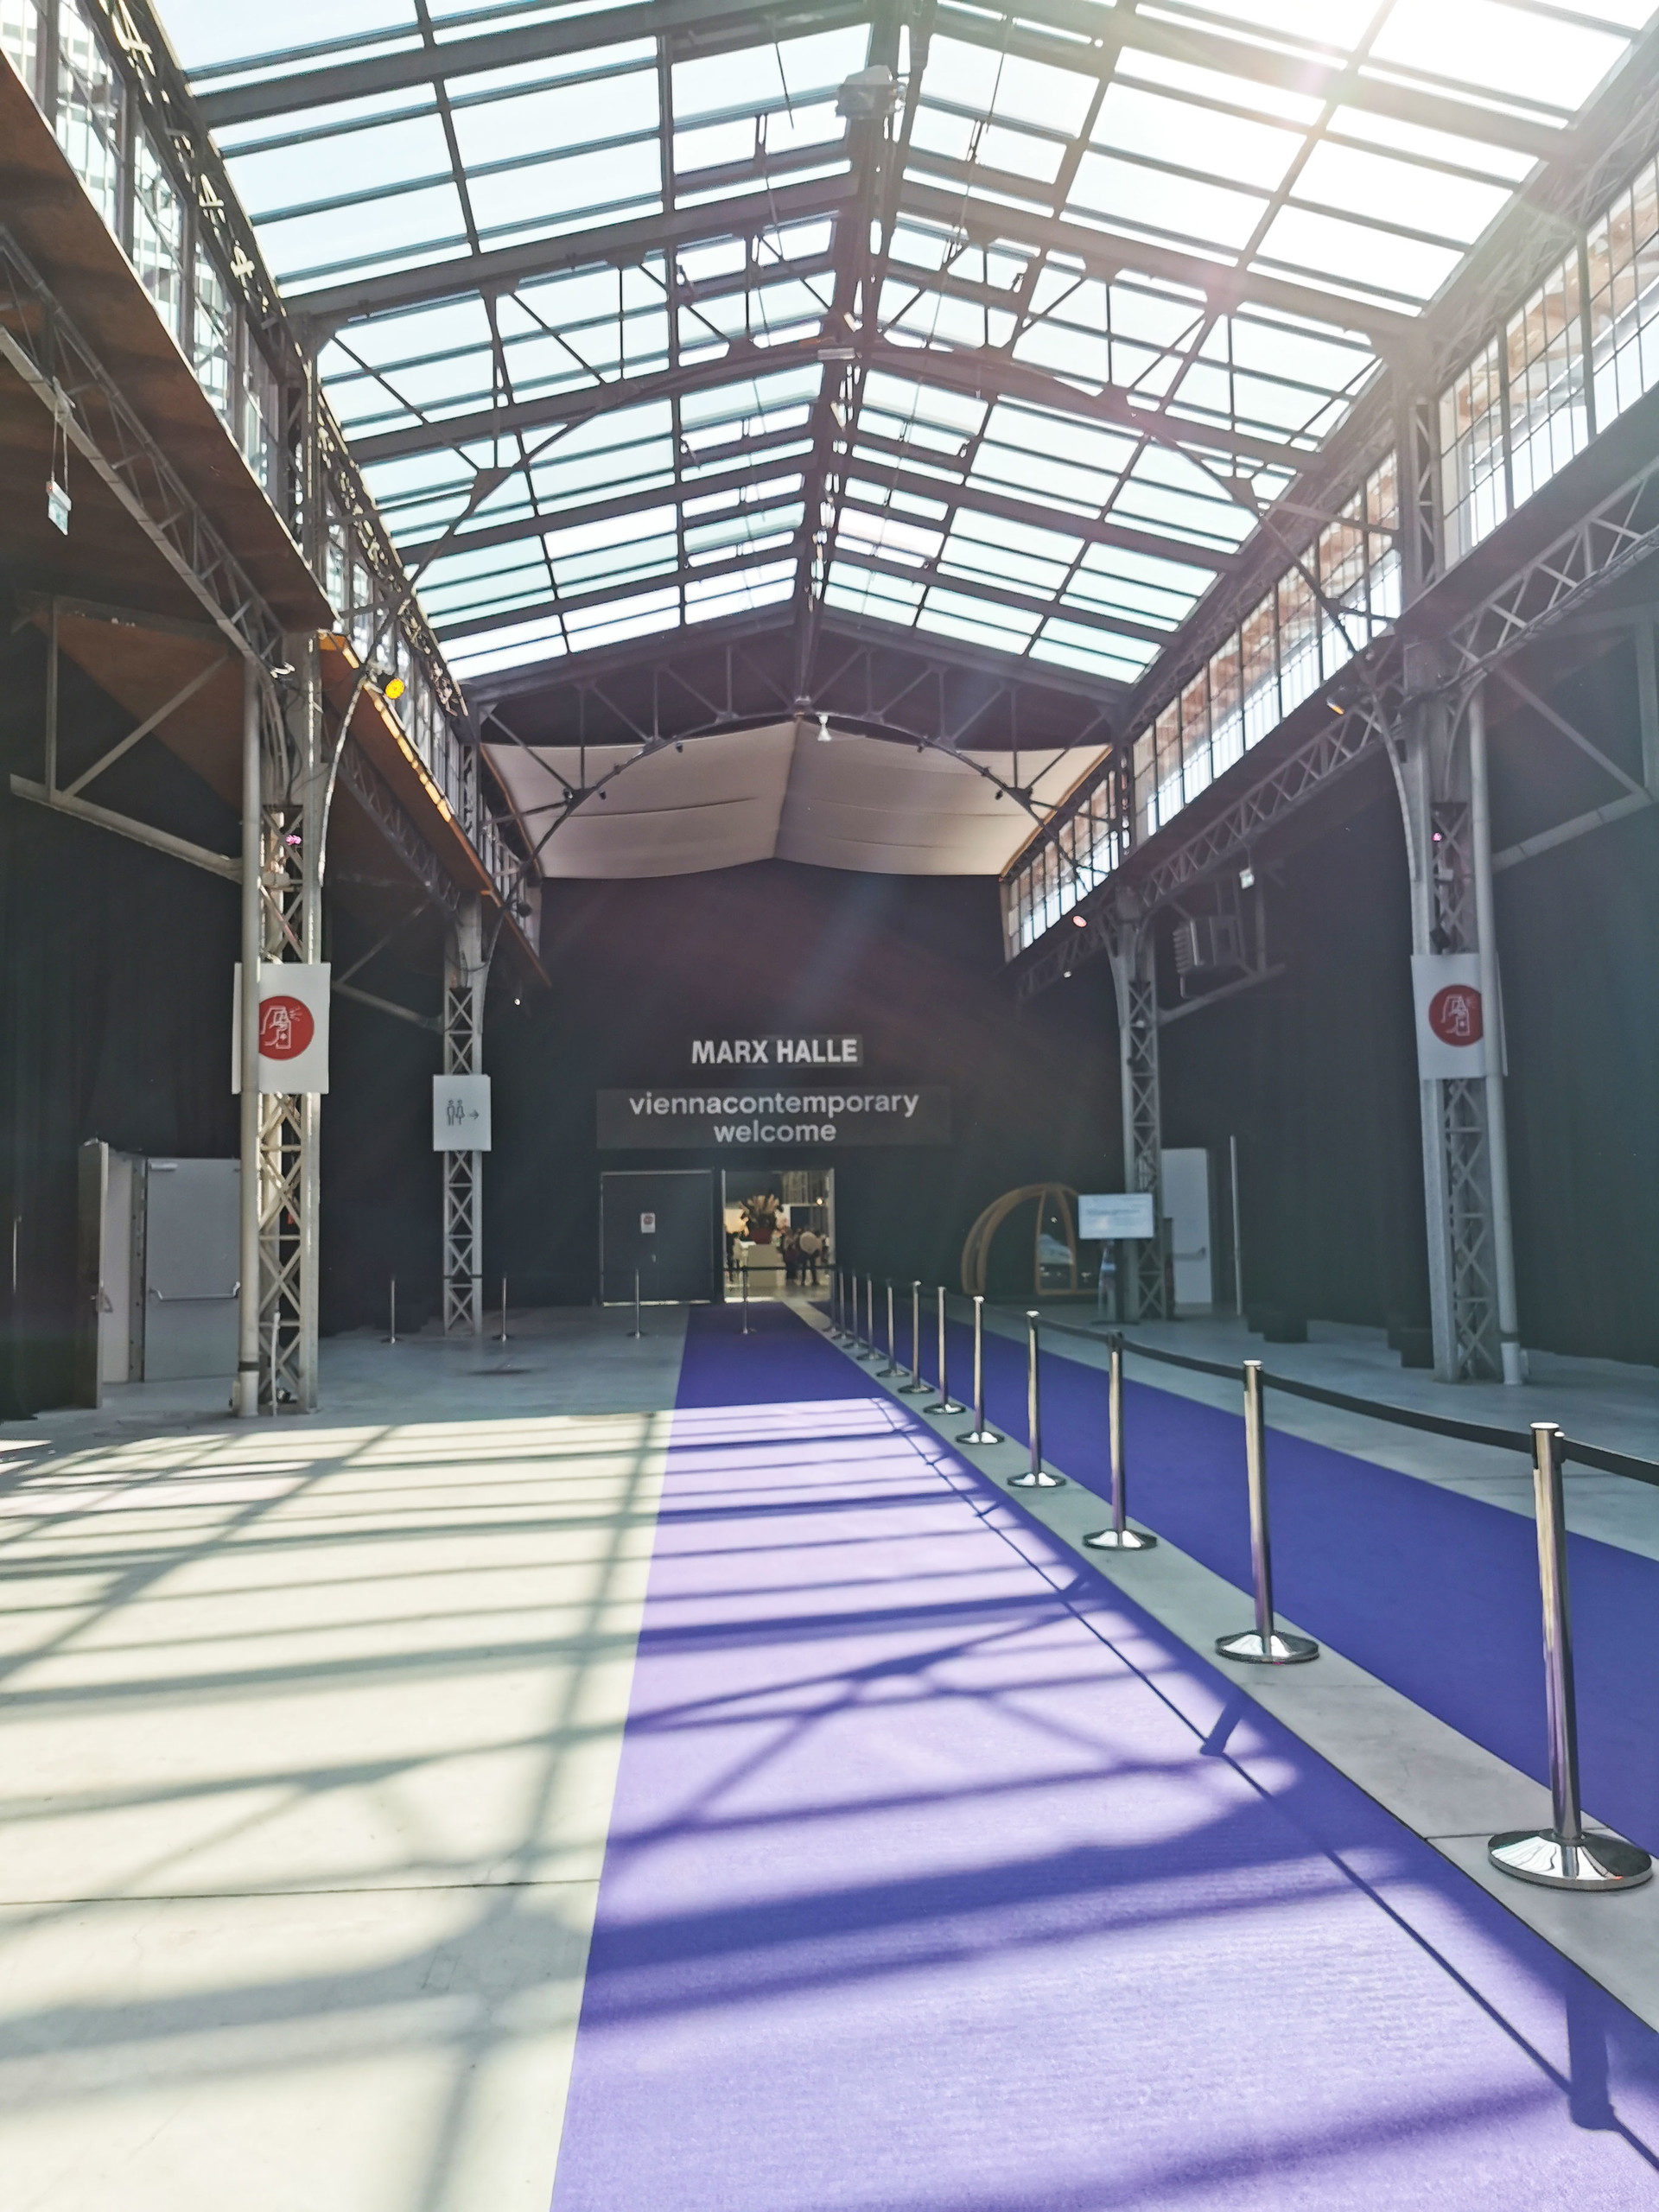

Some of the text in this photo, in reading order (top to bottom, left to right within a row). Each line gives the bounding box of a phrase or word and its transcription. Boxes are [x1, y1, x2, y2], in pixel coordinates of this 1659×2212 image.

[691, 1039, 858, 1064] MARX HALLE
[629, 1091, 919, 1118] viennacontemporary
[714, 1120, 836, 1143] welcome
